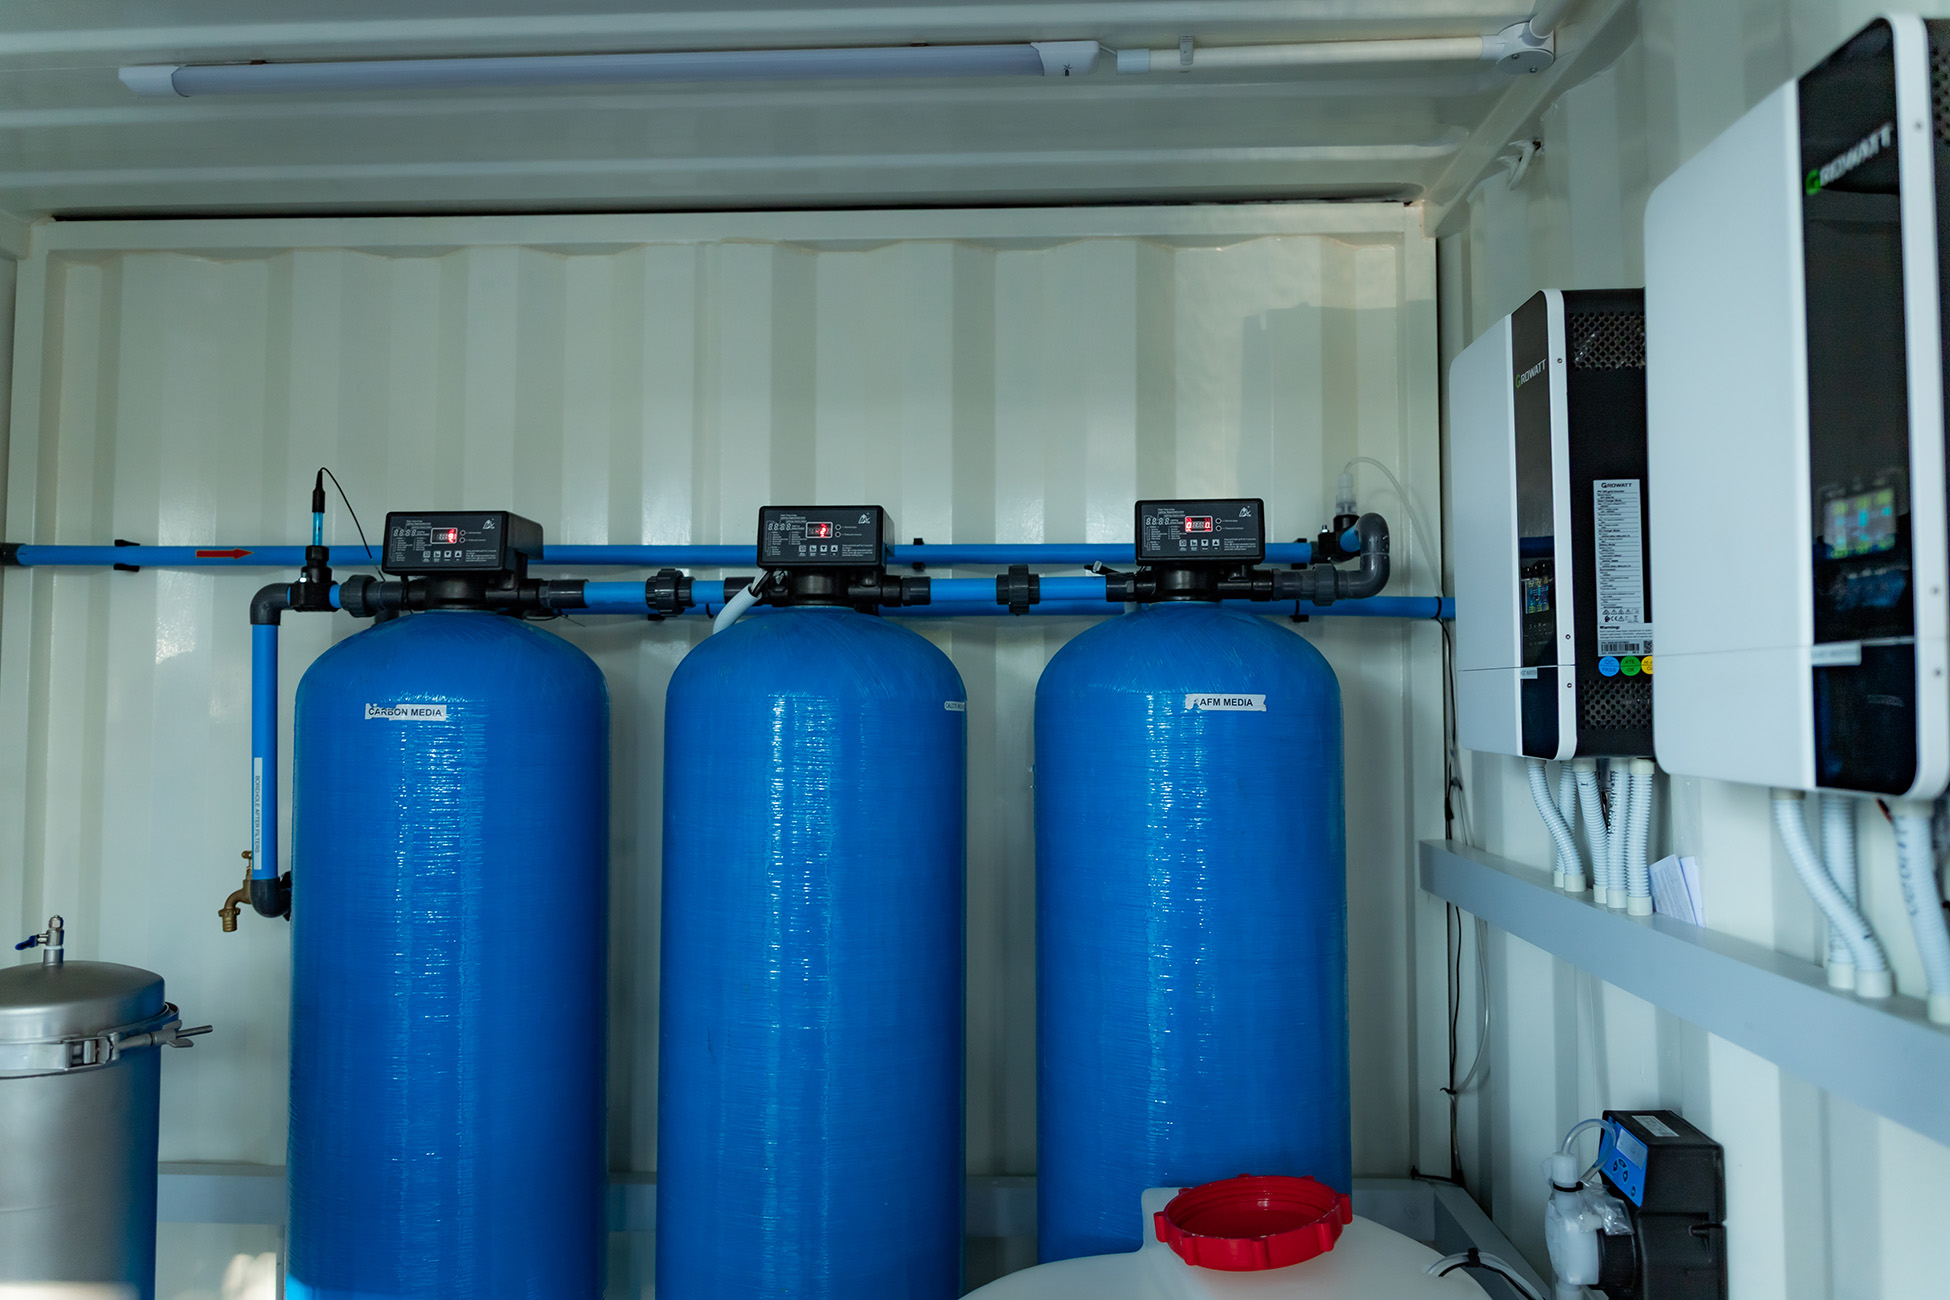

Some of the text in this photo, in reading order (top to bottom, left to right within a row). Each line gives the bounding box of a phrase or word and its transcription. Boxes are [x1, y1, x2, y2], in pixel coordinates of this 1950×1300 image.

[1805, 122, 1893, 196] GROWATT
[1515, 358, 1546, 389] GROWATT
[368, 707, 442, 716] CARBON MEDIA
[1199, 698, 1253, 706] AFM MEDIA
